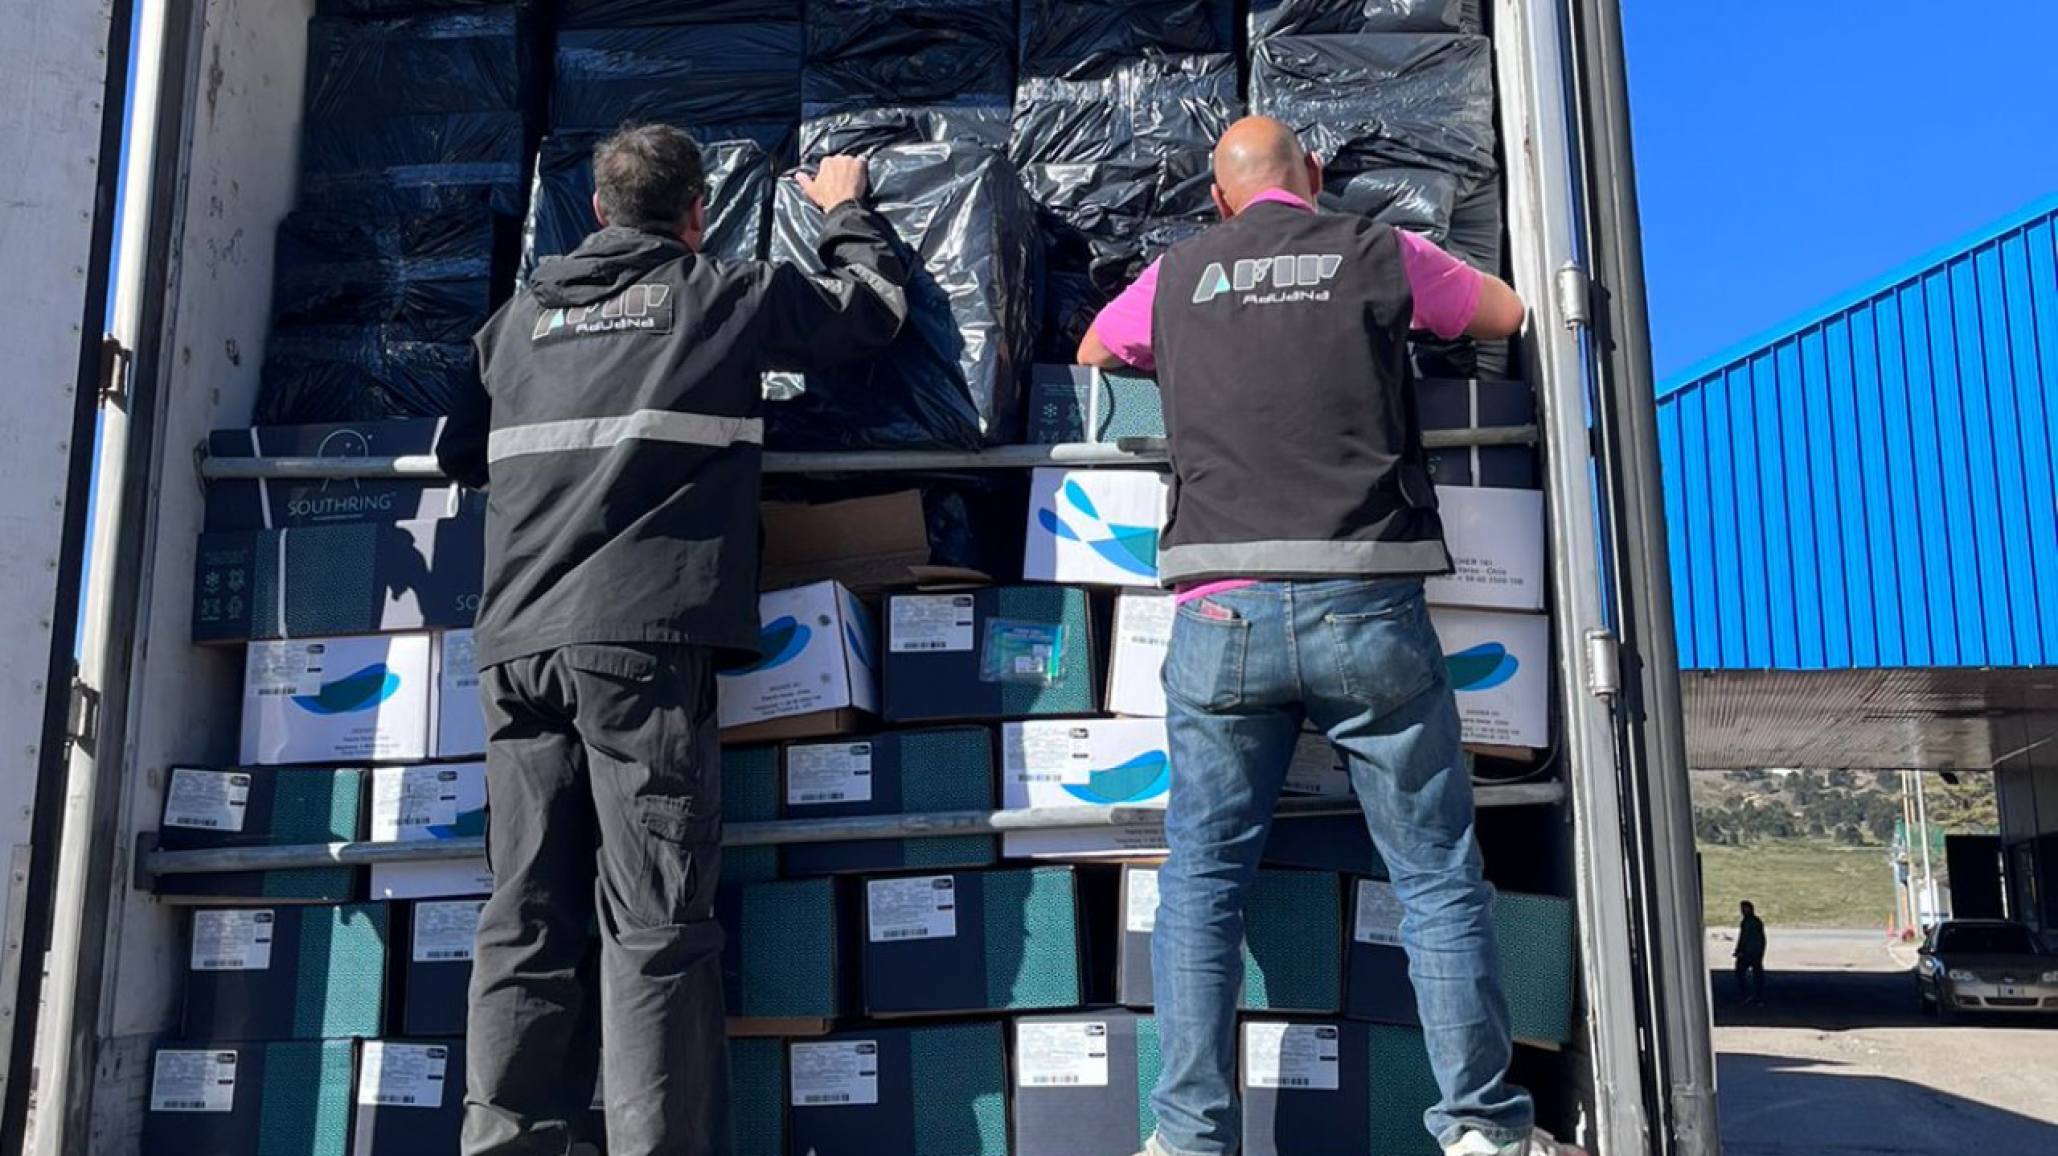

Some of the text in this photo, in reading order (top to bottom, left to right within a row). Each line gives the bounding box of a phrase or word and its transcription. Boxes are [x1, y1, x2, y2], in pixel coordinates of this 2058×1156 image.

[1193, 254, 1343, 303] AFIP
[287, 493, 392, 516] SOUTHRING
[457, 594, 480, 611] SO
